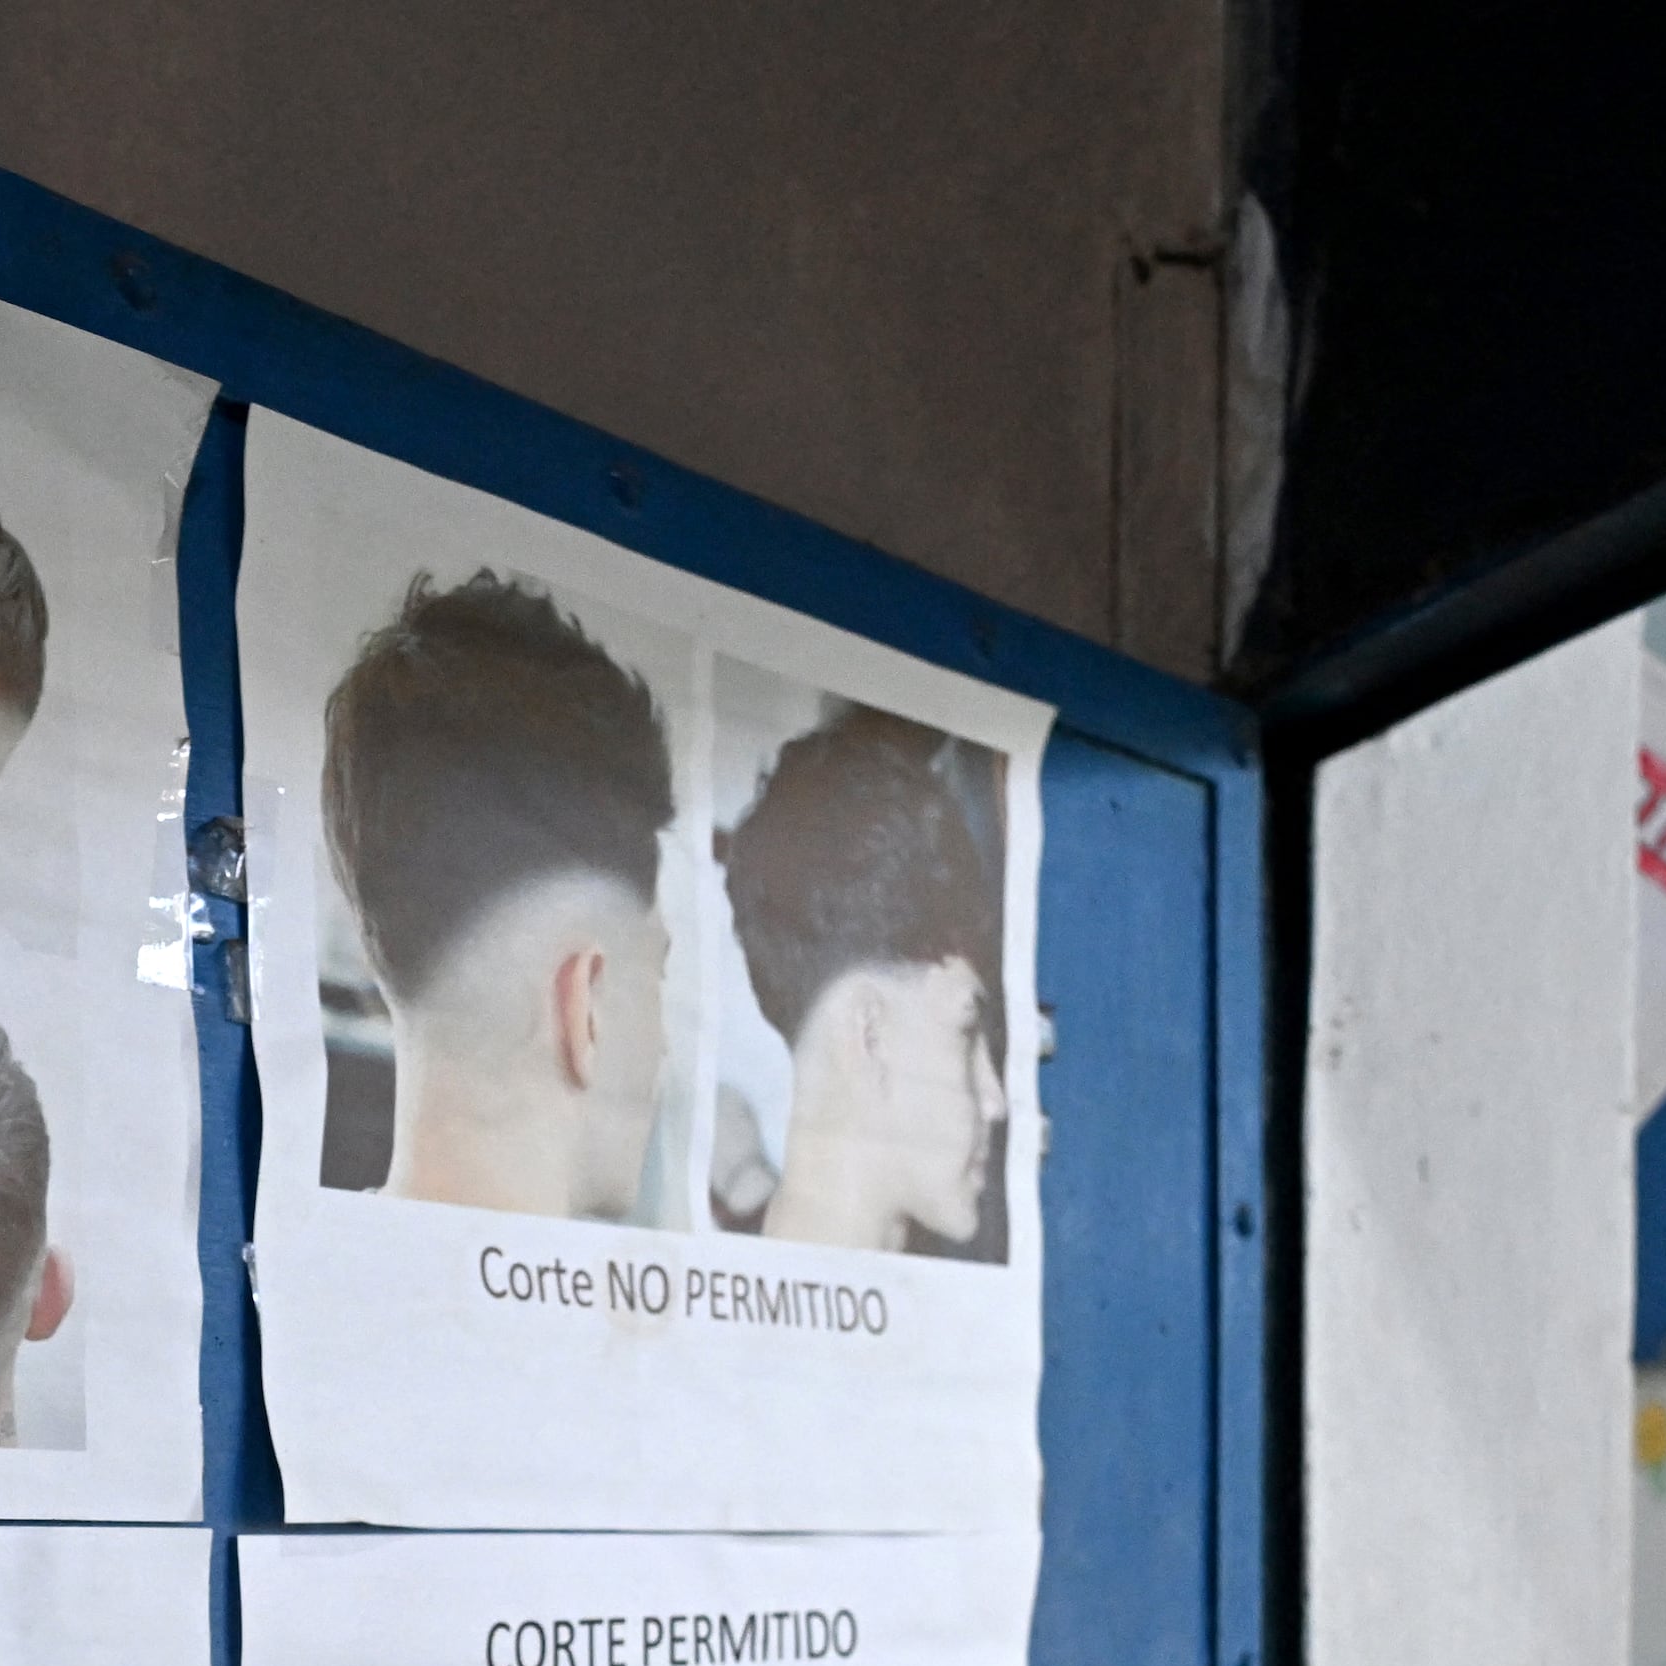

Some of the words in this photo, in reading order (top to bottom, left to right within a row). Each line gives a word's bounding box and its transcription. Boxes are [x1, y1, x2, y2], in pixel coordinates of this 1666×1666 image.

[479, 1246, 594, 1308] Corte
[607, 1260, 671, 1315] NO
[686, 1268, 889, 1335] PERMITIDO
